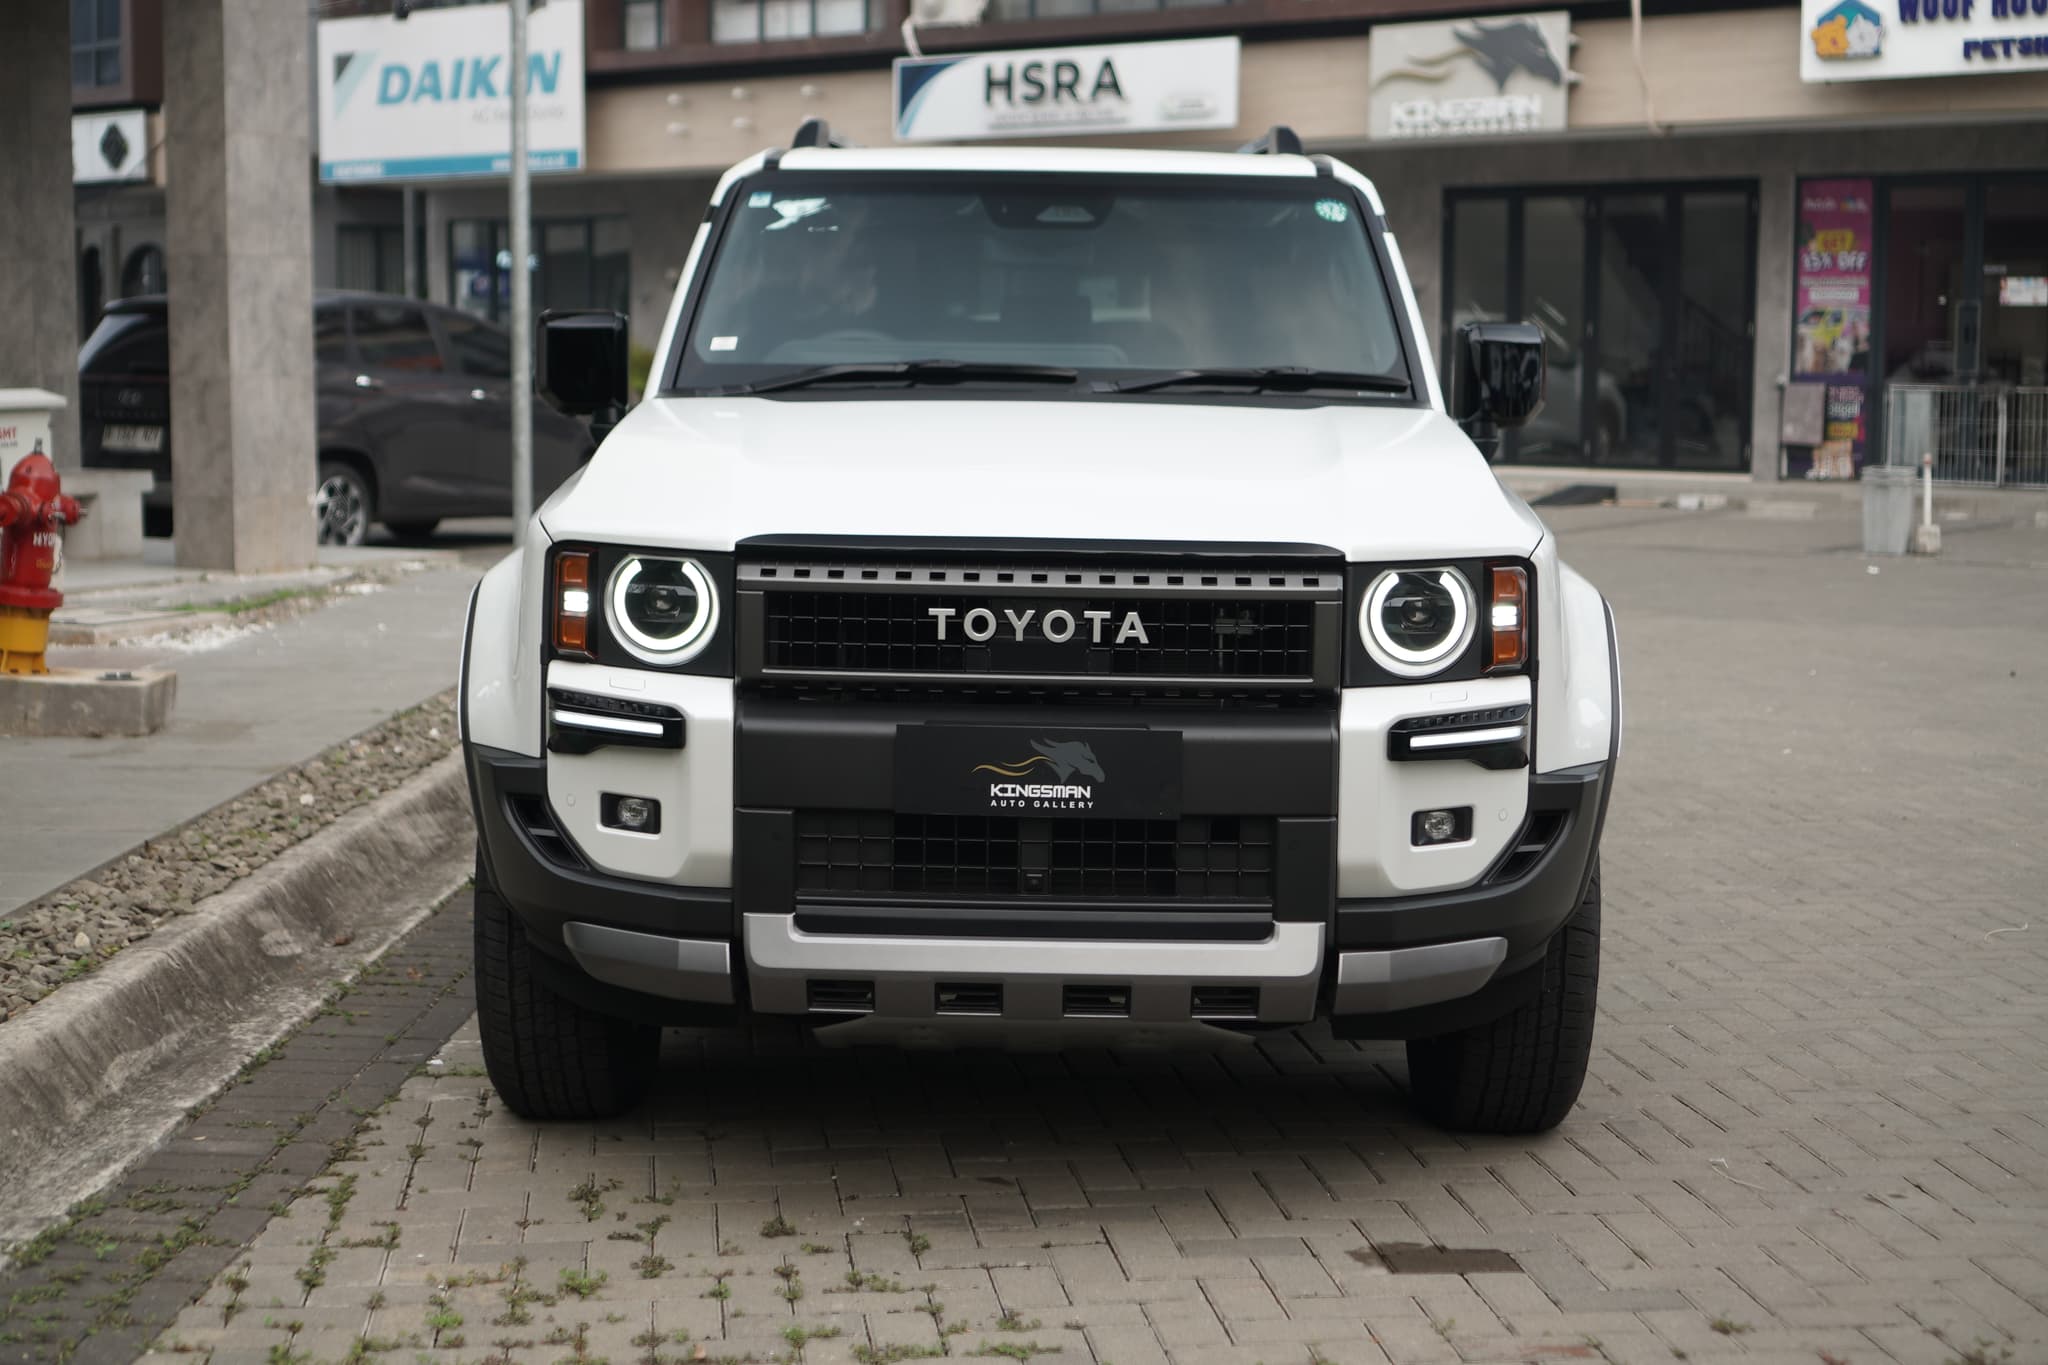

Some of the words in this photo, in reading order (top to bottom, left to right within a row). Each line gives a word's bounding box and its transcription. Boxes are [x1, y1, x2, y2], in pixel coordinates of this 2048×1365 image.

[984, 56, 1124, 106] HSRA
[928, 607, 1150, 644] TOYOTA
[990, 783, 1091, 799] KINGSMAN
[990, 799, 1026, 808] AUTO
[1033, 800, 1094, 809] GALLERY
